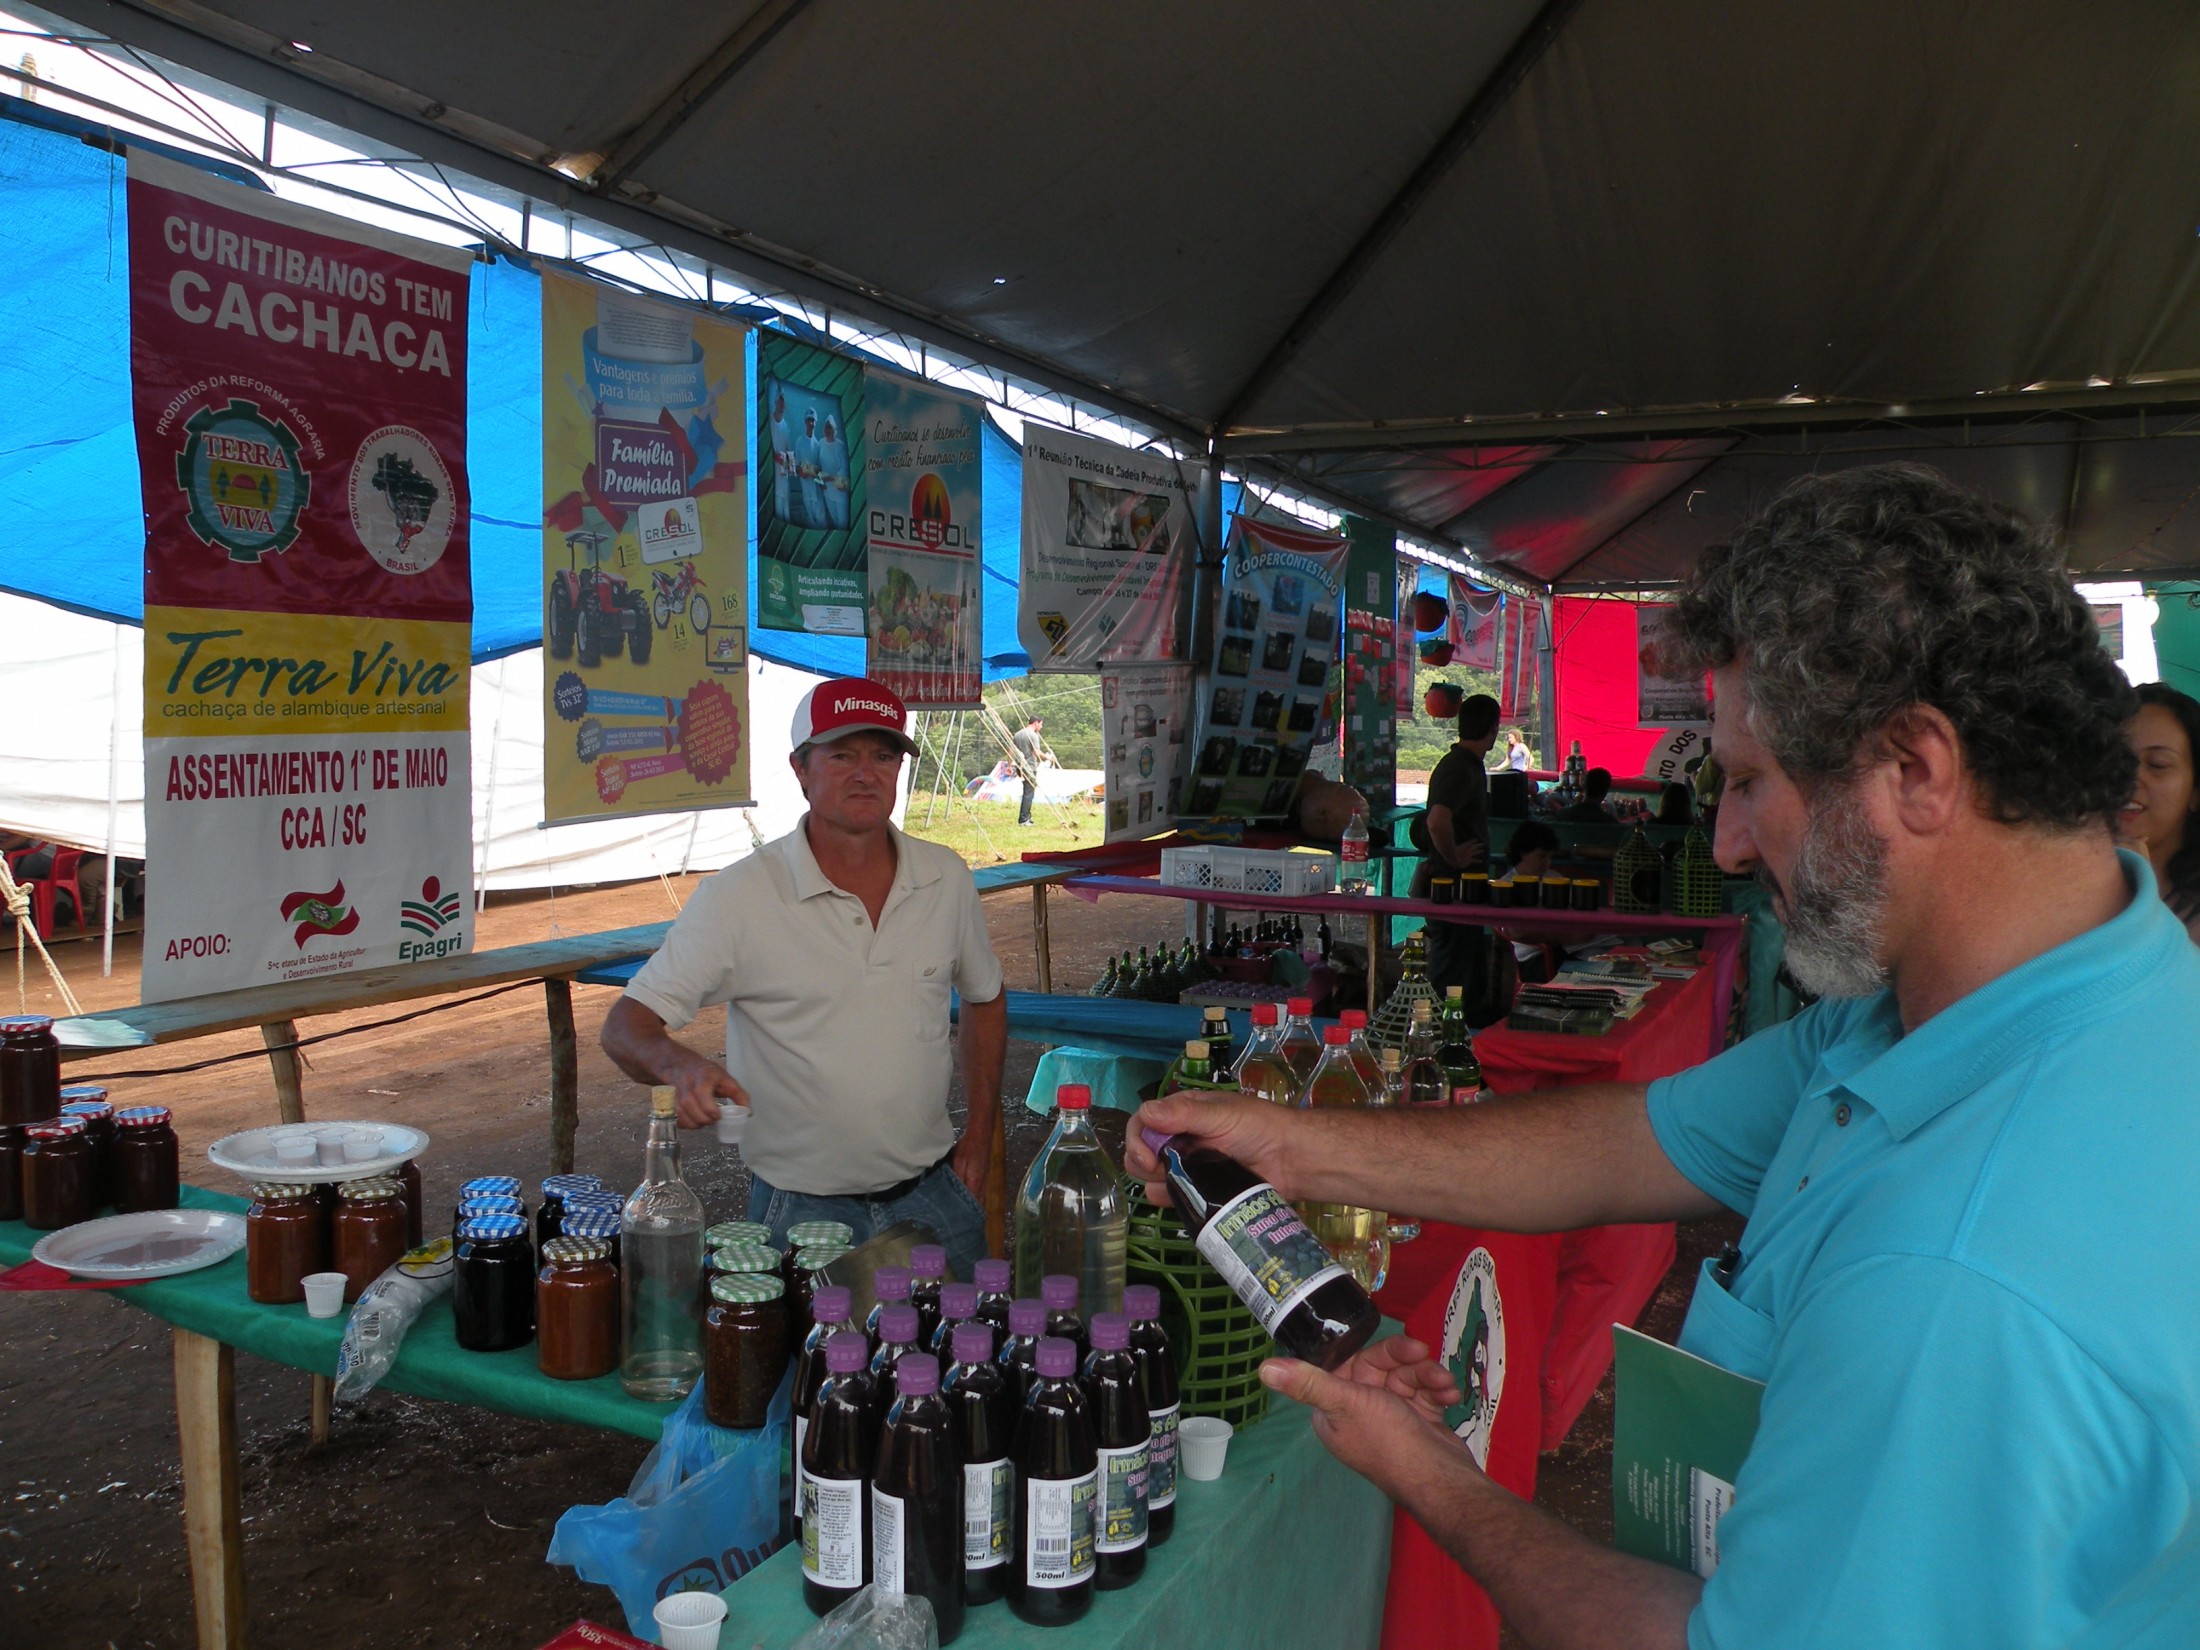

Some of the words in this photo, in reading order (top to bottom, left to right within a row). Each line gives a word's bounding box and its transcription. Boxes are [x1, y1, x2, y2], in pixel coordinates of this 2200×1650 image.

[164, 216, 386, 305] CURITIBANOS
[395, 278, 452, 322] TEM
[170, 270, 451, 377] CACHAÇA
[592, 356, 650, 384] Vantagens
[156, 380, 208, 436] PRODUTOS
[209, 375, 228, 388] DA
[230, 374, 290, 409] REFORMA
[599, 383, 624, 400] para
[627, 386, 650, 402] toda
[874, 420, 919, 444] Curitibanos
[922, 428, 930, 442] se
[202, 432, 291, 470] TERRA
[611, 436, 674, 468] Família
[868, 458, 884, 471] com
[916, 444, 956, 466] financiado
[351, 465, 362, 530] MOVIMENTO
[358, 444, 368, 462] DOS
[366, 427, 428, 447] TRABALHADORES
[428, 446, 448, 478] RURAIS
[1039, 446, 1072, 466] Reunião
[1074, 454, 1105, 474] Técnica
[1106, 462, 1114, 476] da
[1116, 464, 1140, 482] Cadeia
[1142, 470, 1172, 488] Produtiva
[604, 468, 682, 496] Premiada
[216, 503, 277, 535] VIVA
[645, 522, 695, 540] CRESOL
[870, 511, 975, 550] CRESOL
[386, 558, 419, 572] BRASIL
[617, 544, 627, 568] 1
[1038, 552, 1084, 568] Desenvolvimento
[1085, 557, 1114, 570] Regional
[798, 574, 832, 586] Articulando
[1234, 552, 1340, 597] COOPERCONTESTADO
[722, 593, 739, 612] 168
[798, 588, 830, 598] ampliando
[674, 622, 686, 640] 14
[166, 628, 339, 698] Terra
[347, 640, 459, 696] Viva
[556, 684, 582, 700] Sorteios
[162, 700, 247, 720] cachaça
[253, 699, 276, 716] de
[282, 700, 370, 719] alambique
[376, 700, 447, 716] artesanal
[834, 696, 899, 721] Minasgás
[1668, 730, 1698, 756] DOS
[166, 750, 345, 801] ASSENTAMENTO
[373, 748, 400, 790] DE
[406, 746, 448, 788] MAIO
[280, 806, 326, 850] CCA
[331, 804, 338, 847] /
[342, 803, 367, 846] SC
[165, 933, 232, 962] APOIO:
[299, 956, 308, 966] de
[308, 953, 329, 964] Estado
[330, 952, 338, 962] da
[398, 932, 462, 964] Epagri
[288, 962, 338, 979] Desenvolvimento
[338, 960, 354, 970] Rural
[1217, 1195, 1271, 1240] Irmãos
[1246, 1214, 1279, 1238] Suco
[1462, 1252, 1483, 1284] RURAIS
[1482, 1253, 1494, 1279] SEM
[1705, 1546, 1712, 1558] SC
[1034, 1571, 1066, 1580] 500ml
[576, 1624, 604, 1644] 350g
